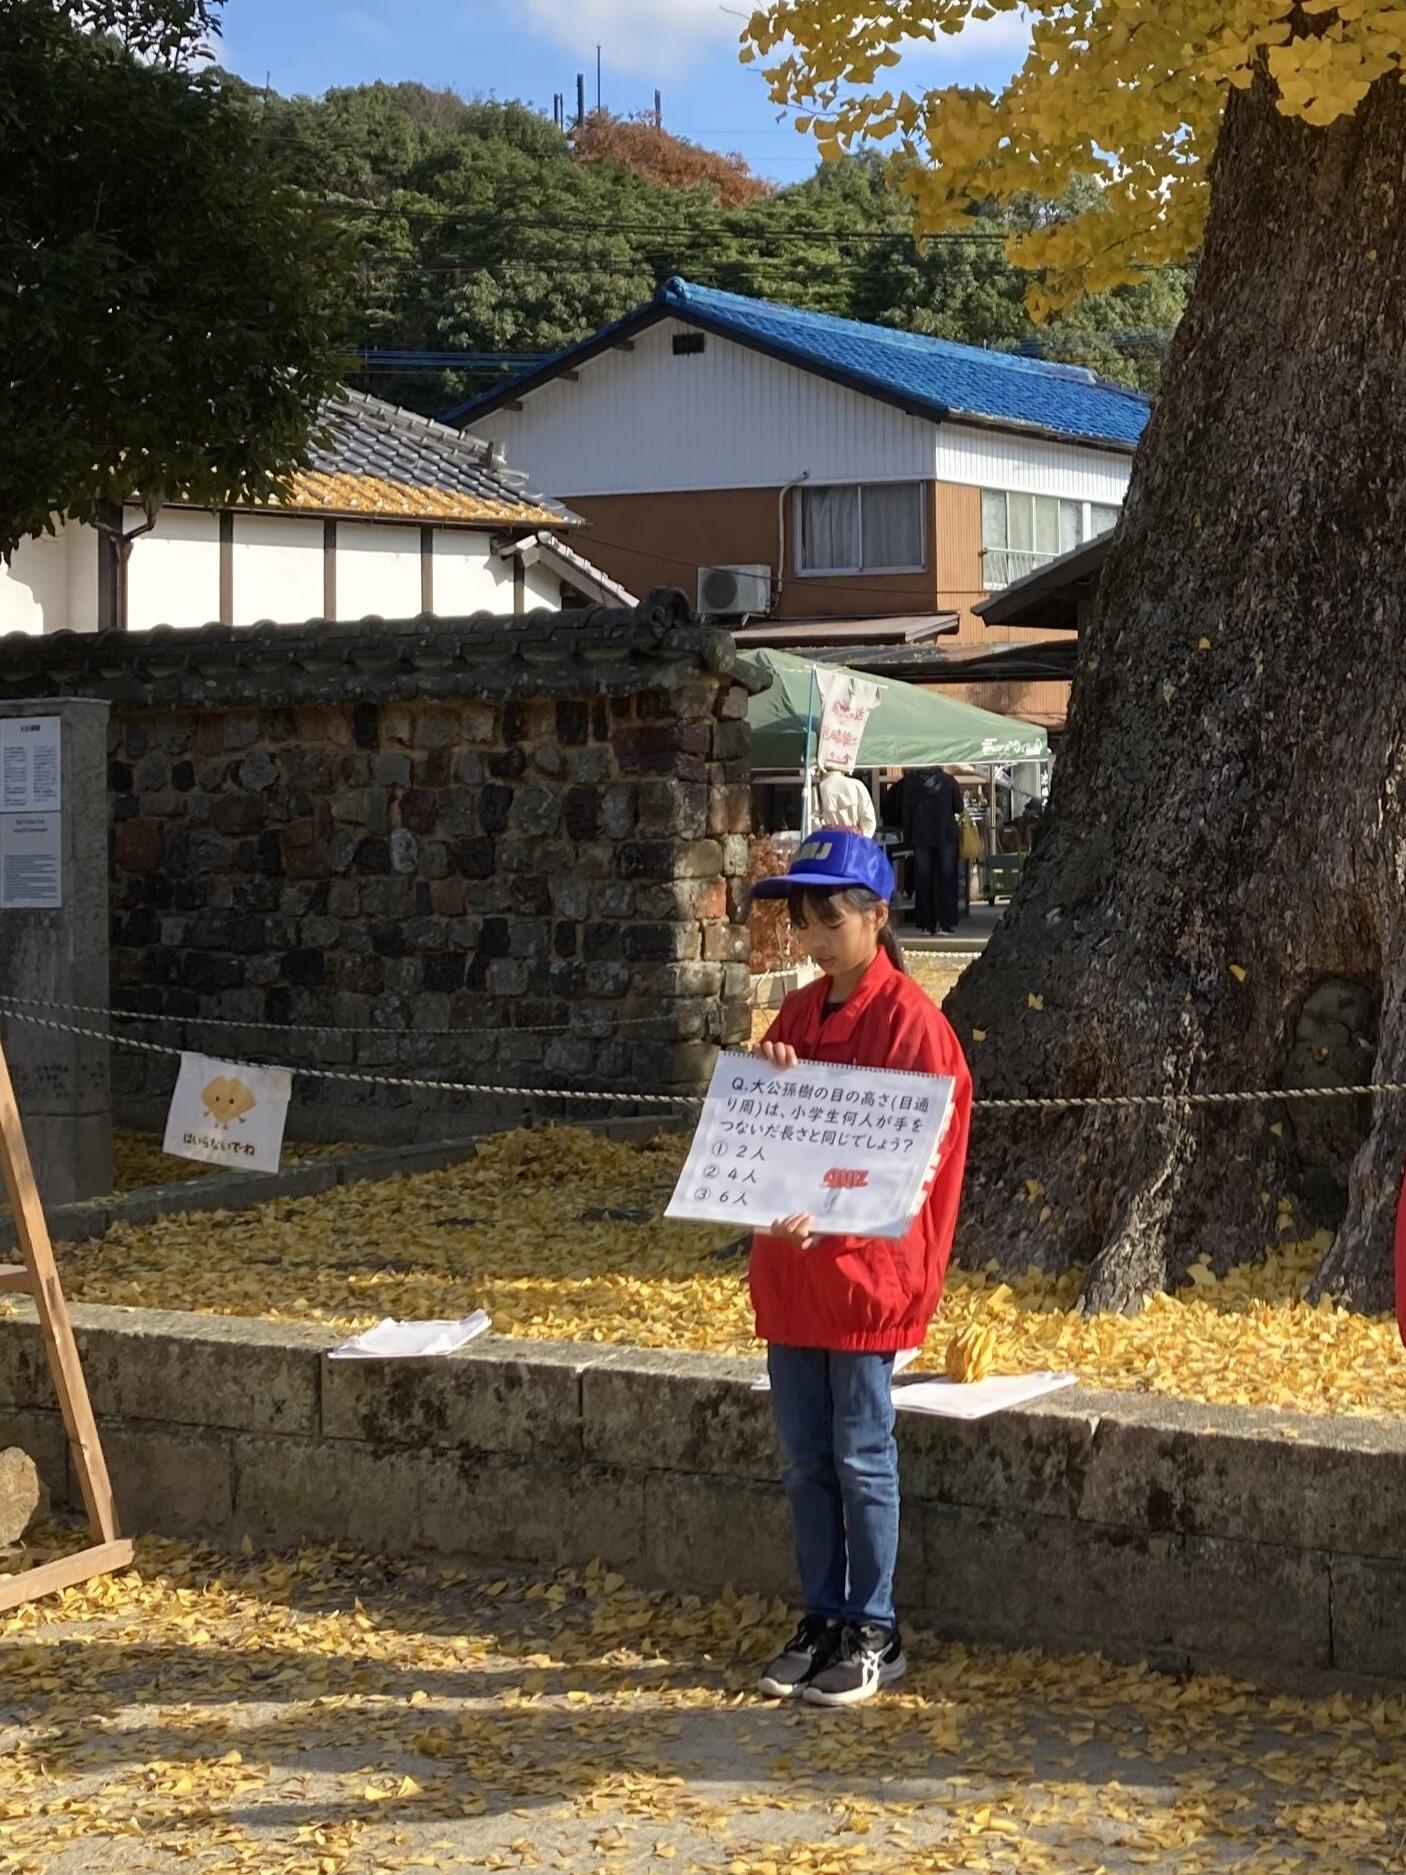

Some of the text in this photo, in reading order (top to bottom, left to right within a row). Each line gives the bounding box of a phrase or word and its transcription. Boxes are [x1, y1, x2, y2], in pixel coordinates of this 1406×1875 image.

[183, 1132, 256, 1156] はいらないでね
